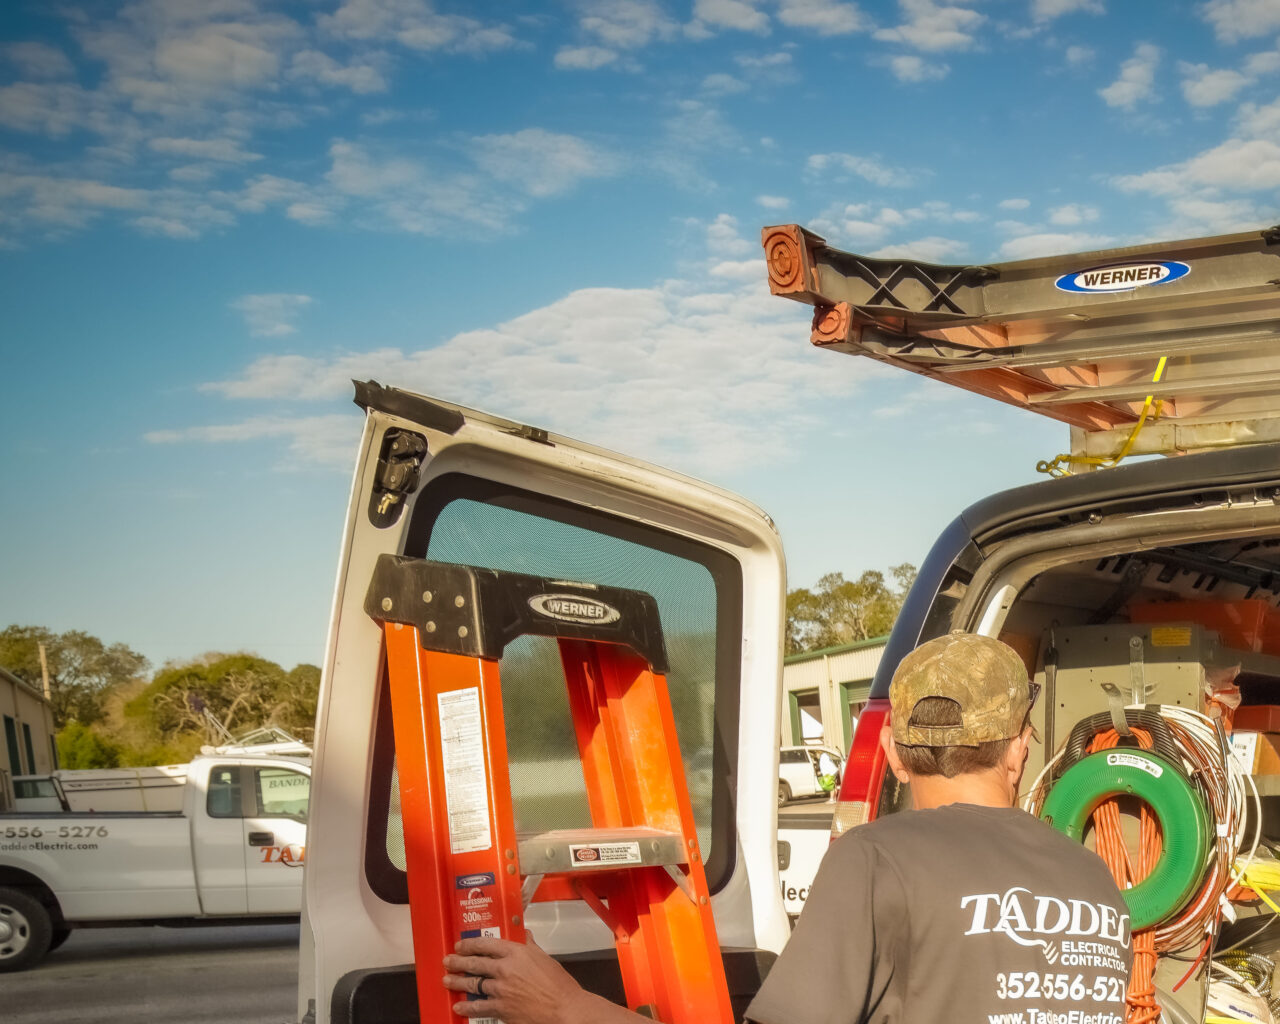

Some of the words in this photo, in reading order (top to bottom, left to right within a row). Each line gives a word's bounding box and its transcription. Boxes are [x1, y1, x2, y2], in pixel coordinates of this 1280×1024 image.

[1084, 266, 1161, 286] WERNER
[547, 599, 604, 617] WERNER
[0, 841, 98, 851] addeoElectric.com
[781, 880, 811, 901] lec
[1061, 940, 1120, 959] ELECTRICAL
